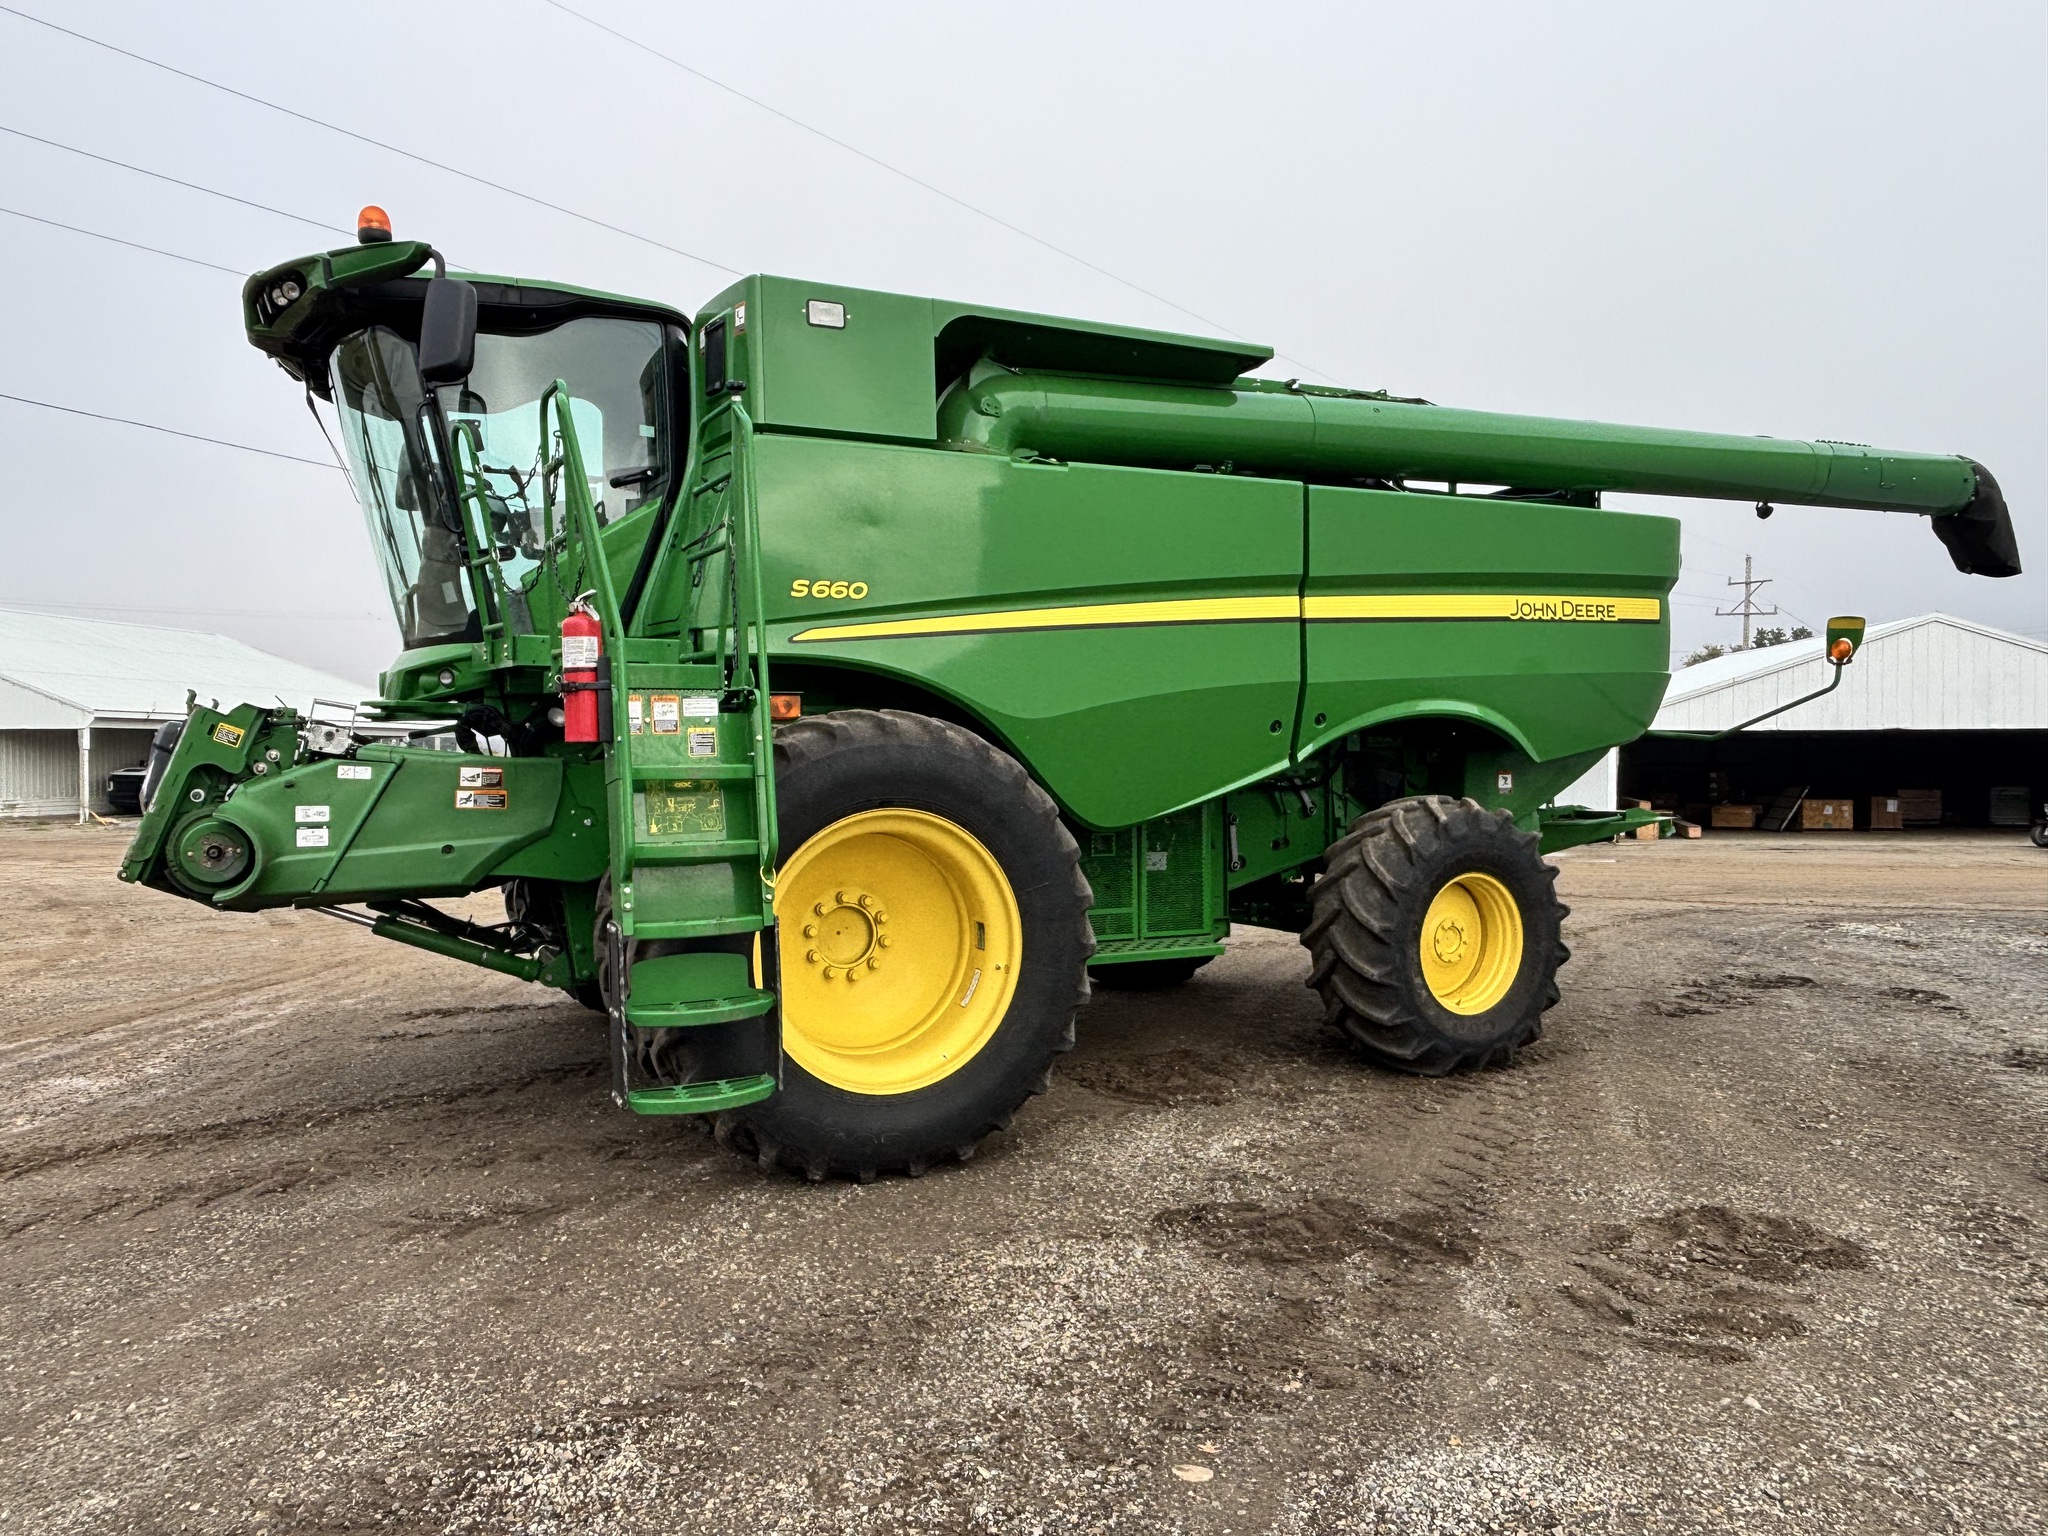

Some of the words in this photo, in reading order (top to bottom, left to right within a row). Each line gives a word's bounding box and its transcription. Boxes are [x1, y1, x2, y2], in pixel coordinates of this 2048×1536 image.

[790, 579, 868, 600] S660
[1510, 599, 1557, 617] JOHN
[1561, 600, 1616, 618] DEERE
